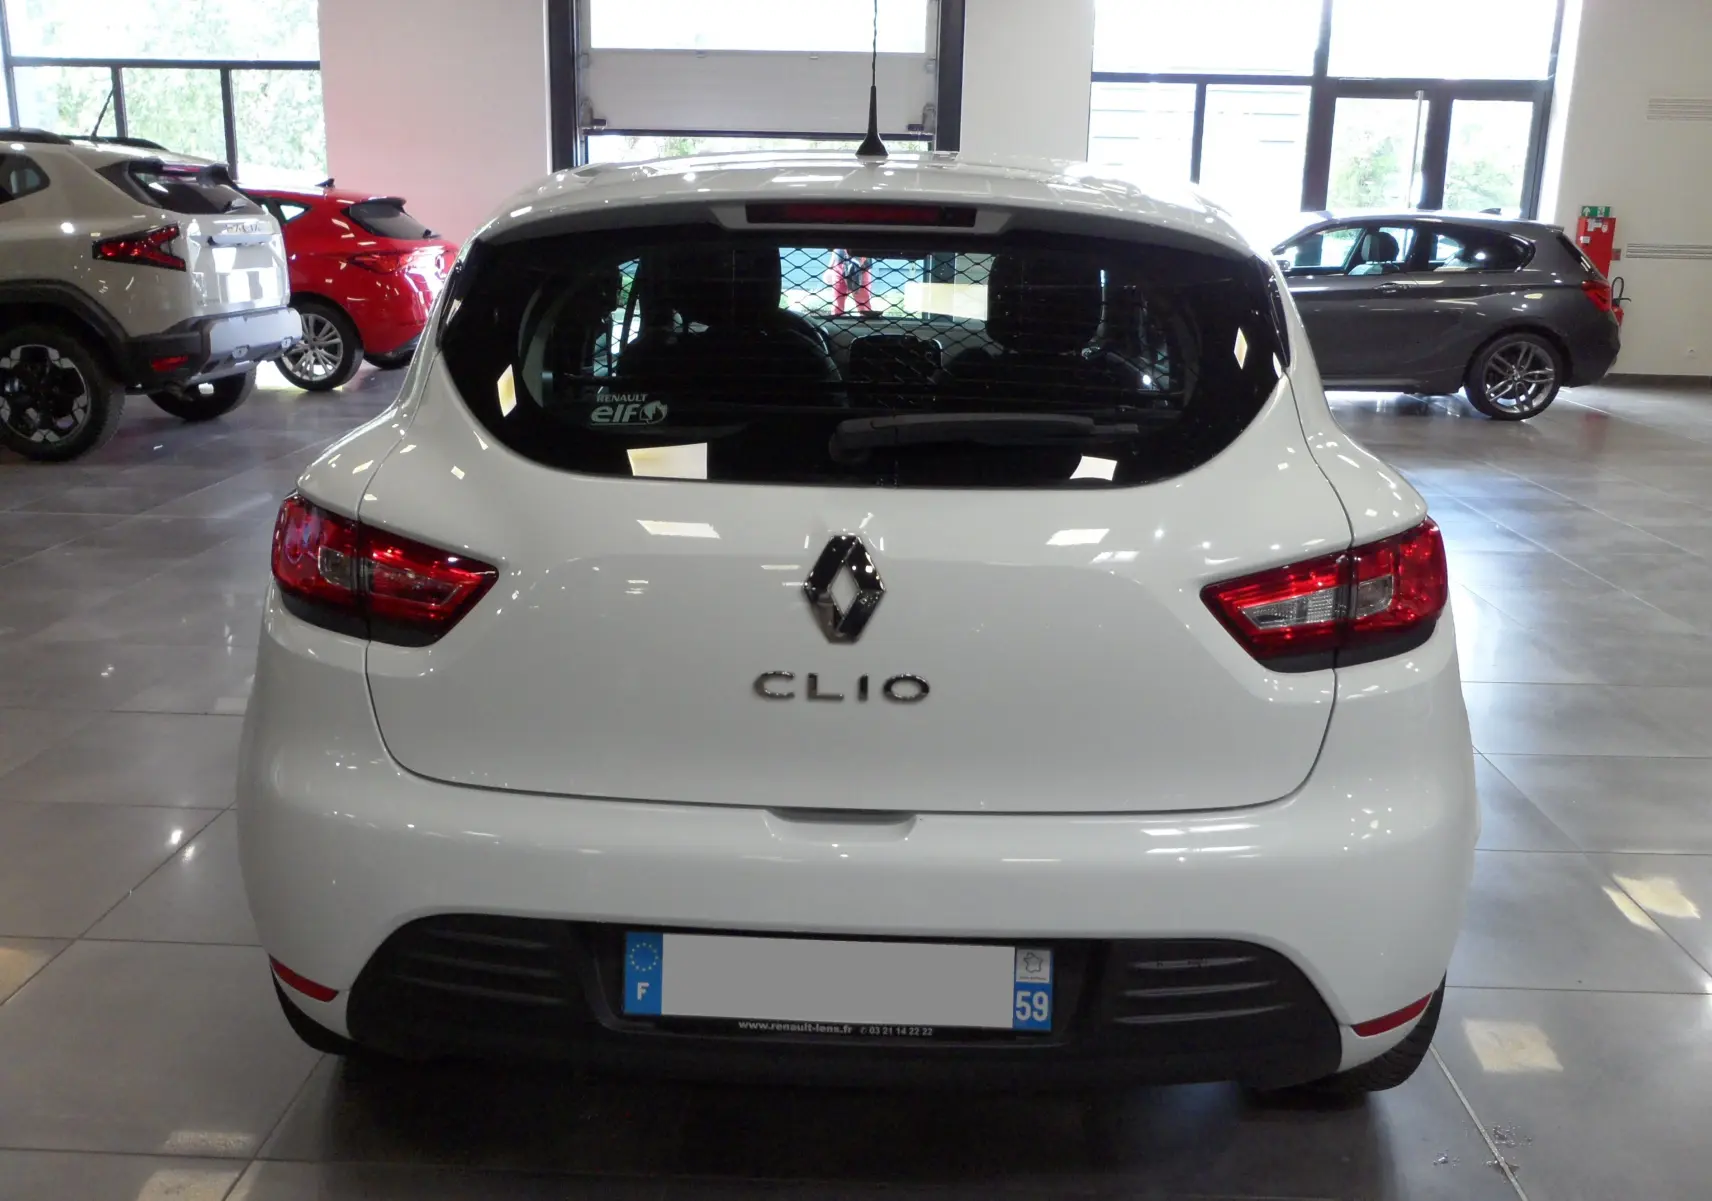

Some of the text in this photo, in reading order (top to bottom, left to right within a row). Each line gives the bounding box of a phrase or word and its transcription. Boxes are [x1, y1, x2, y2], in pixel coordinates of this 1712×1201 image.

[597, 393, 648, 402] RENAULT
[591, 403, 640, 422] elf
[752, 670, 931, 704] CLIO
[637, 981, 650, 1001] F
[1015, 990, 1049, 1022] 59
[738, 1021, 853, 1035] www.renault-lens.fr
[869, 1026, 881, 1035] 03
[882, 1026, 893, 1035] 21
[909, 1026, 920, 1036] 22
[922, 1027, 933, 1036] 22
